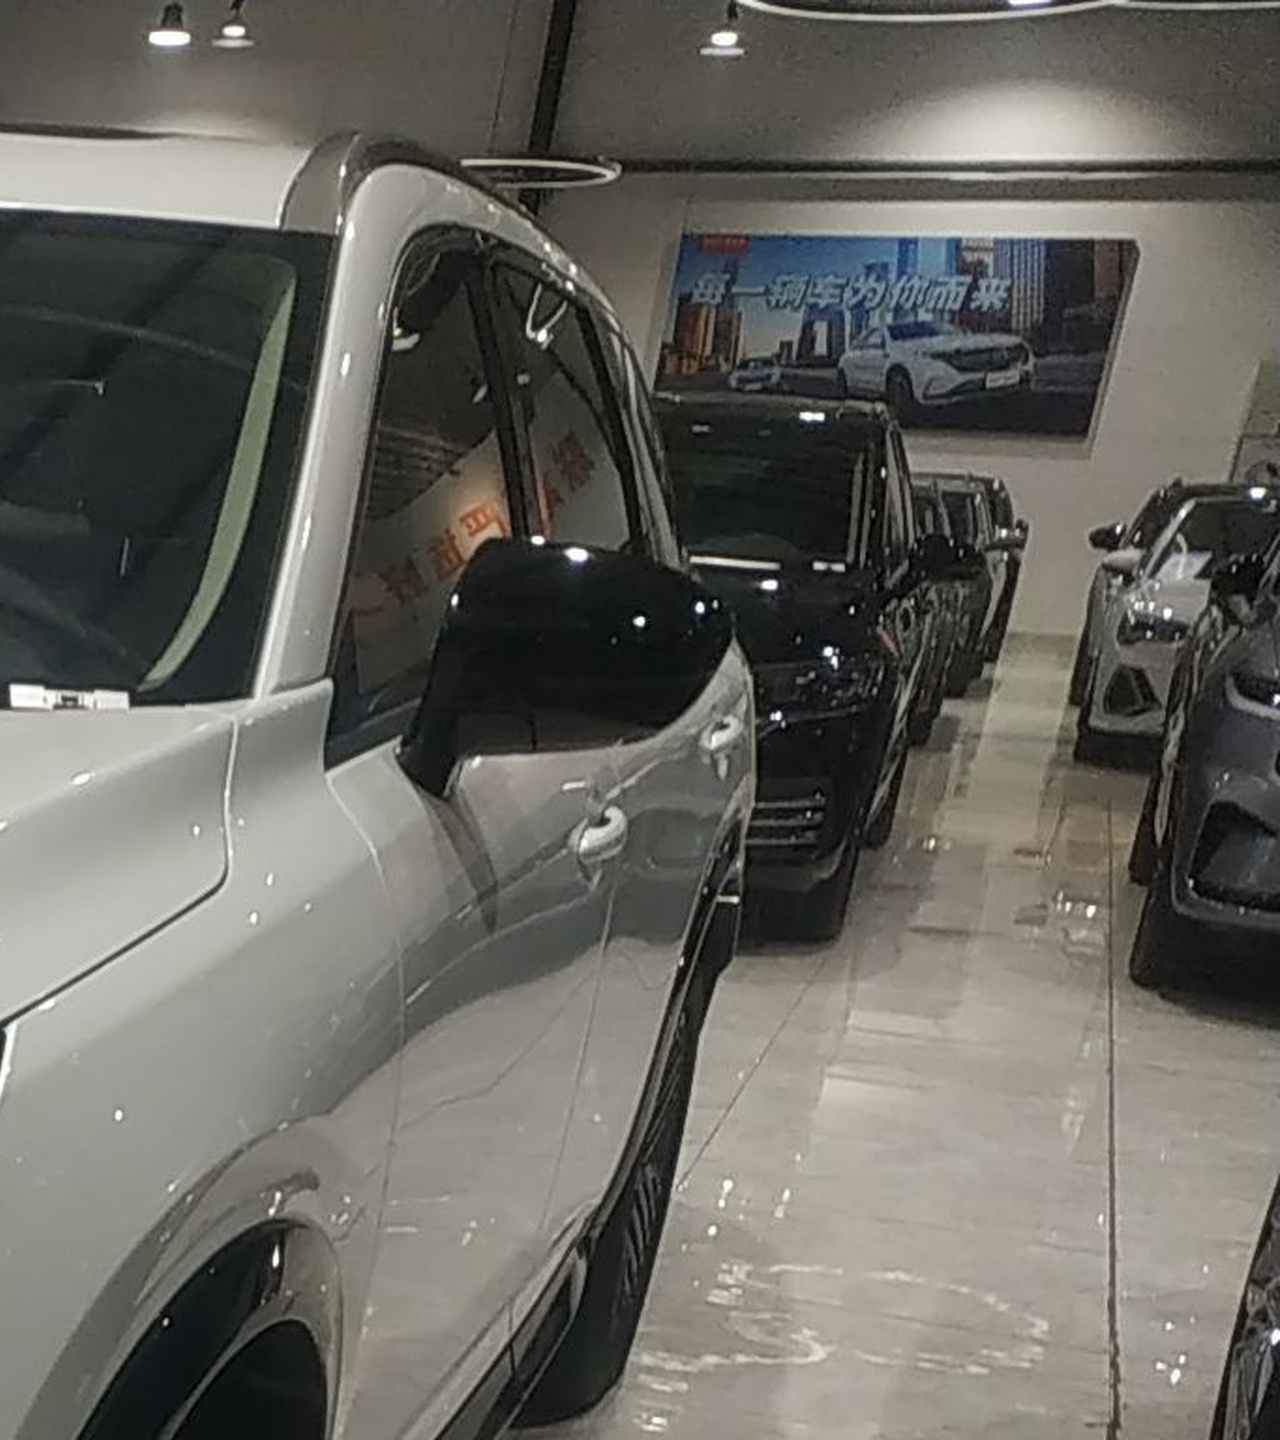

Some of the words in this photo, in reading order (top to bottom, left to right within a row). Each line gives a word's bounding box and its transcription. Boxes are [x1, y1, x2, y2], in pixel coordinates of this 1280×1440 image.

[692, 273, 1009, 312] 每一辆车为你而来
